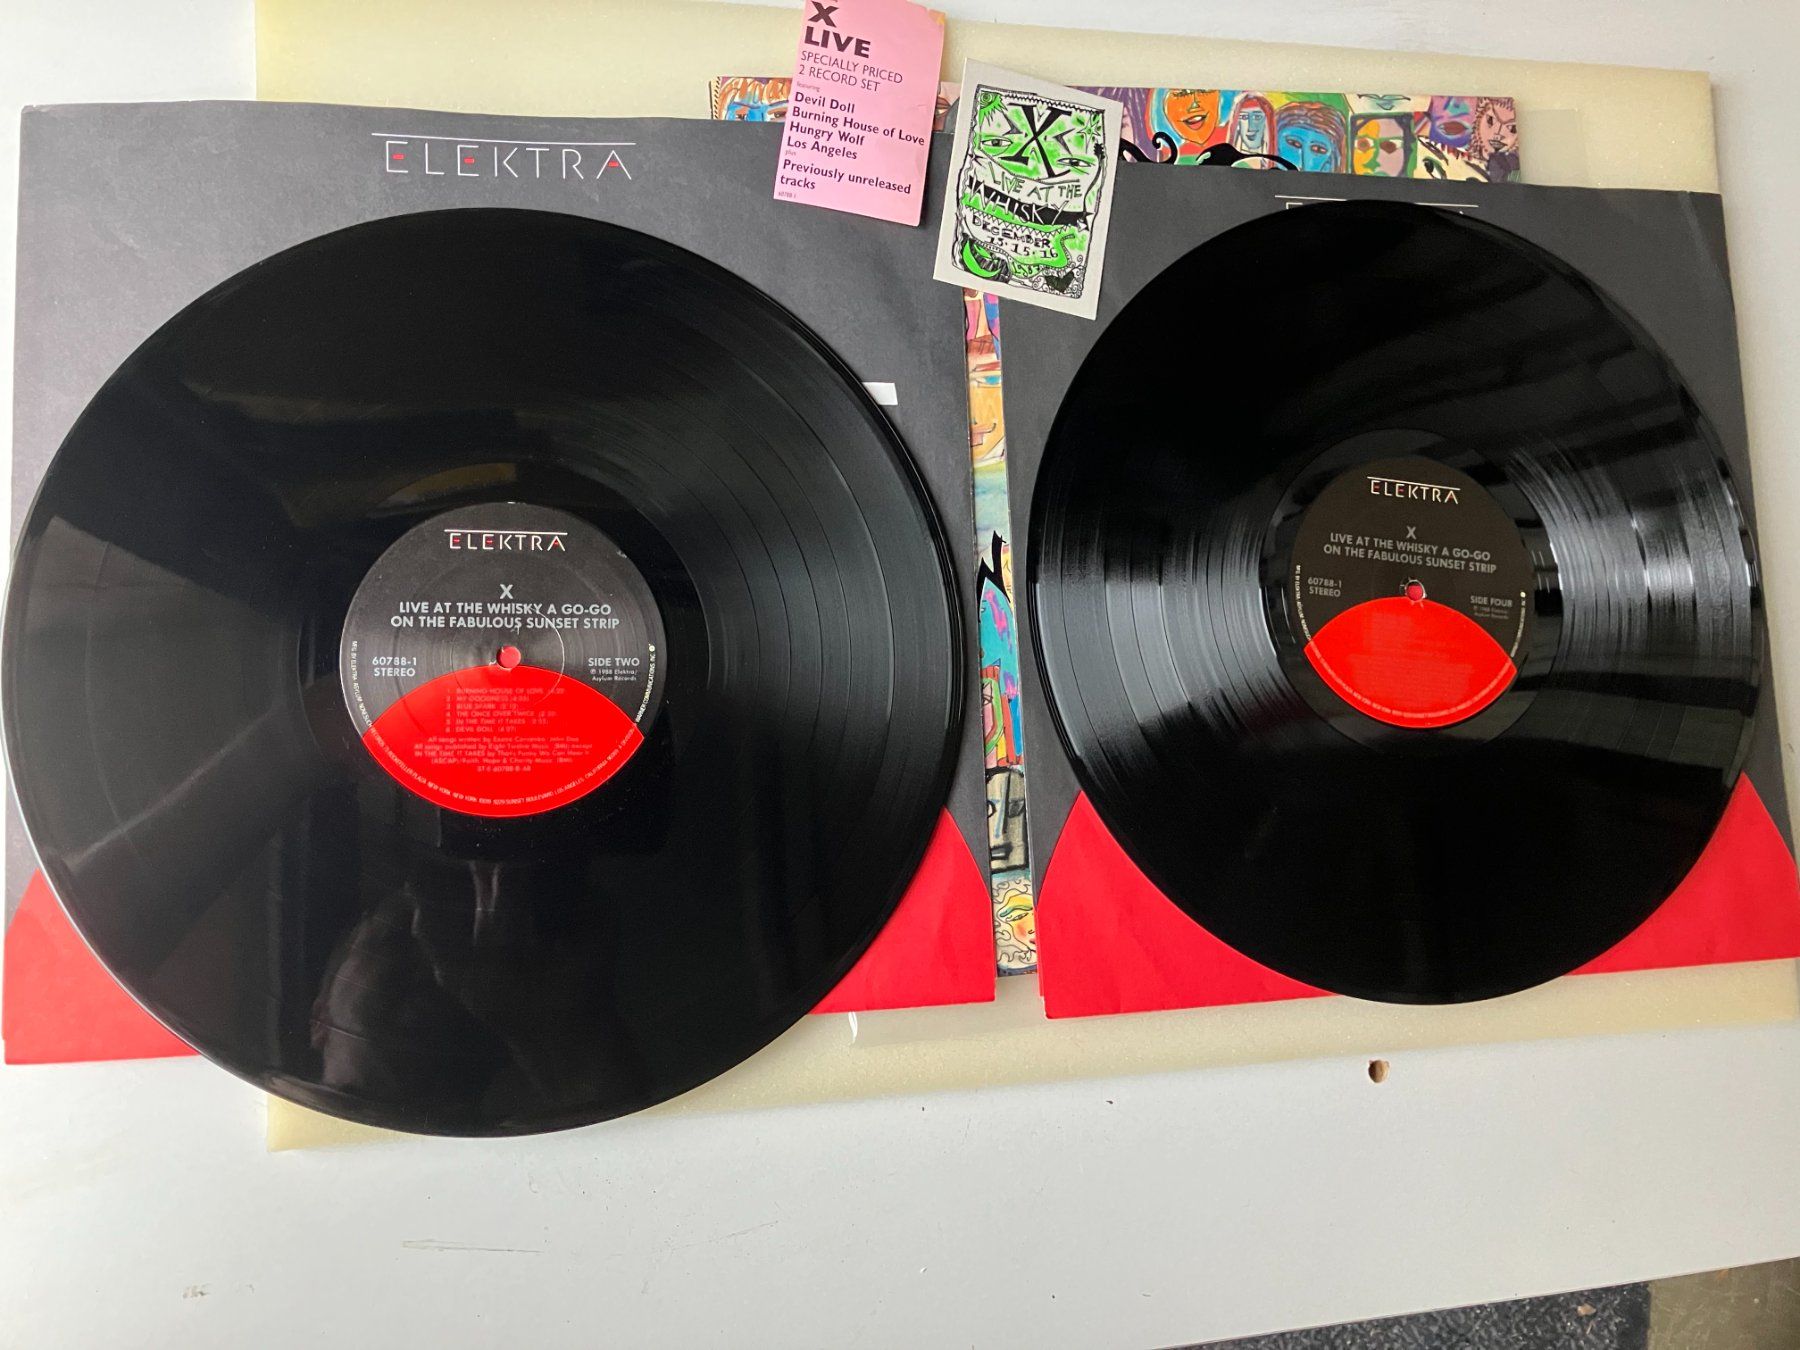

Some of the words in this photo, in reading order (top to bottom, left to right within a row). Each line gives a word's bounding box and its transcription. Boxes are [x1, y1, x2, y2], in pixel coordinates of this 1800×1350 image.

[808, 1, 839, 28] X
[804, 26, 871, 58] LIVE
[799, 64, 805, 75] 2
[809, 66, 858, 87] RECORD
[861, 78, 880, 92] SET
[801, 50, 859, 72] SPECIALLY
[862, 65, 903, 84] PRICED
[795, 92, 826, 107] Devil
[830, 99, 855, 114] Doll
[790, 122, 834, 142] Hungry
[838, 130, 864, 146] Wolf
[792, 106, 838, 128] Burning
[843, 117, 879, 134] House
[883, 124, 895, 137] of
[899, 129, 925, 146] Love
[787, 136, 806, 149] Los
[811, 141, 858, 160] Angeles
[999, 102, 1072, 178] X
[386, 140, 632, 180] ELEKTRA
[780, 174, 816, 190] tracks
[783, 158, 844, 182] Previously
[848, 174, 911, 194] unreleased
[989, 162, 1025, 192] LIVE
[1027, 182, 1054, 202] AT
[1058, 184, 1082, 198] THE
[968, 179, 1070, 225] WHISKY
[1370, 479, 1459, 505] ELEKTRA
[450, 532, 566, 551] ELEKTRA
[1406, 526, 1417, 540] X
[1323, 544, 1340, 555] ON
[1344, 546, 1365, 558] THE
[1368, 549, 1422, 565] FABULOUS
[1426, 556, 1465, 570] SUNSET
[1469, 562, 1497, 573] STRIP
[1330, 532, 1352, 545] LIVE
[1356, 536, 1371, 546] AT
[1374, 538, 1393, 549] THE
[1396, 541, 1438, 555] WHISKY
[1442, 547, 1450, 556] A
[1452, 548, 1490, 561] GO-GO
[500, 584, 513, 600] X
[1307, 577, 1342, 588] 60788-1
[1309, 586, 1341, 597] STEREO
[400, 602, 429, 614] LIVE
[433, 602, 451, 614] AT
[456, 602, 483, 614] THE
[487, 603, 543, 614] WHISKY
[547, 604, 557, 614] A
[562, 604, 612, 615] GO-GO
[1470, 595, 1488, 604] SIDE
[1490, 597, 1512, 607] FOUR
[390, 616, 414, 627] ON
[419, 616, 445, 628] THE
[450, 616, 522, 629] FABULOUS
[526, 618, 578, 629] SUNSET
[583, 618, 620, 629] STRIP
[372, 657, 417, 666] 60788-1
[374, 668, 416, 677] STEREO
[588, 657, 611, 666] SIDE
[615, 657, 640, 666] TWO
